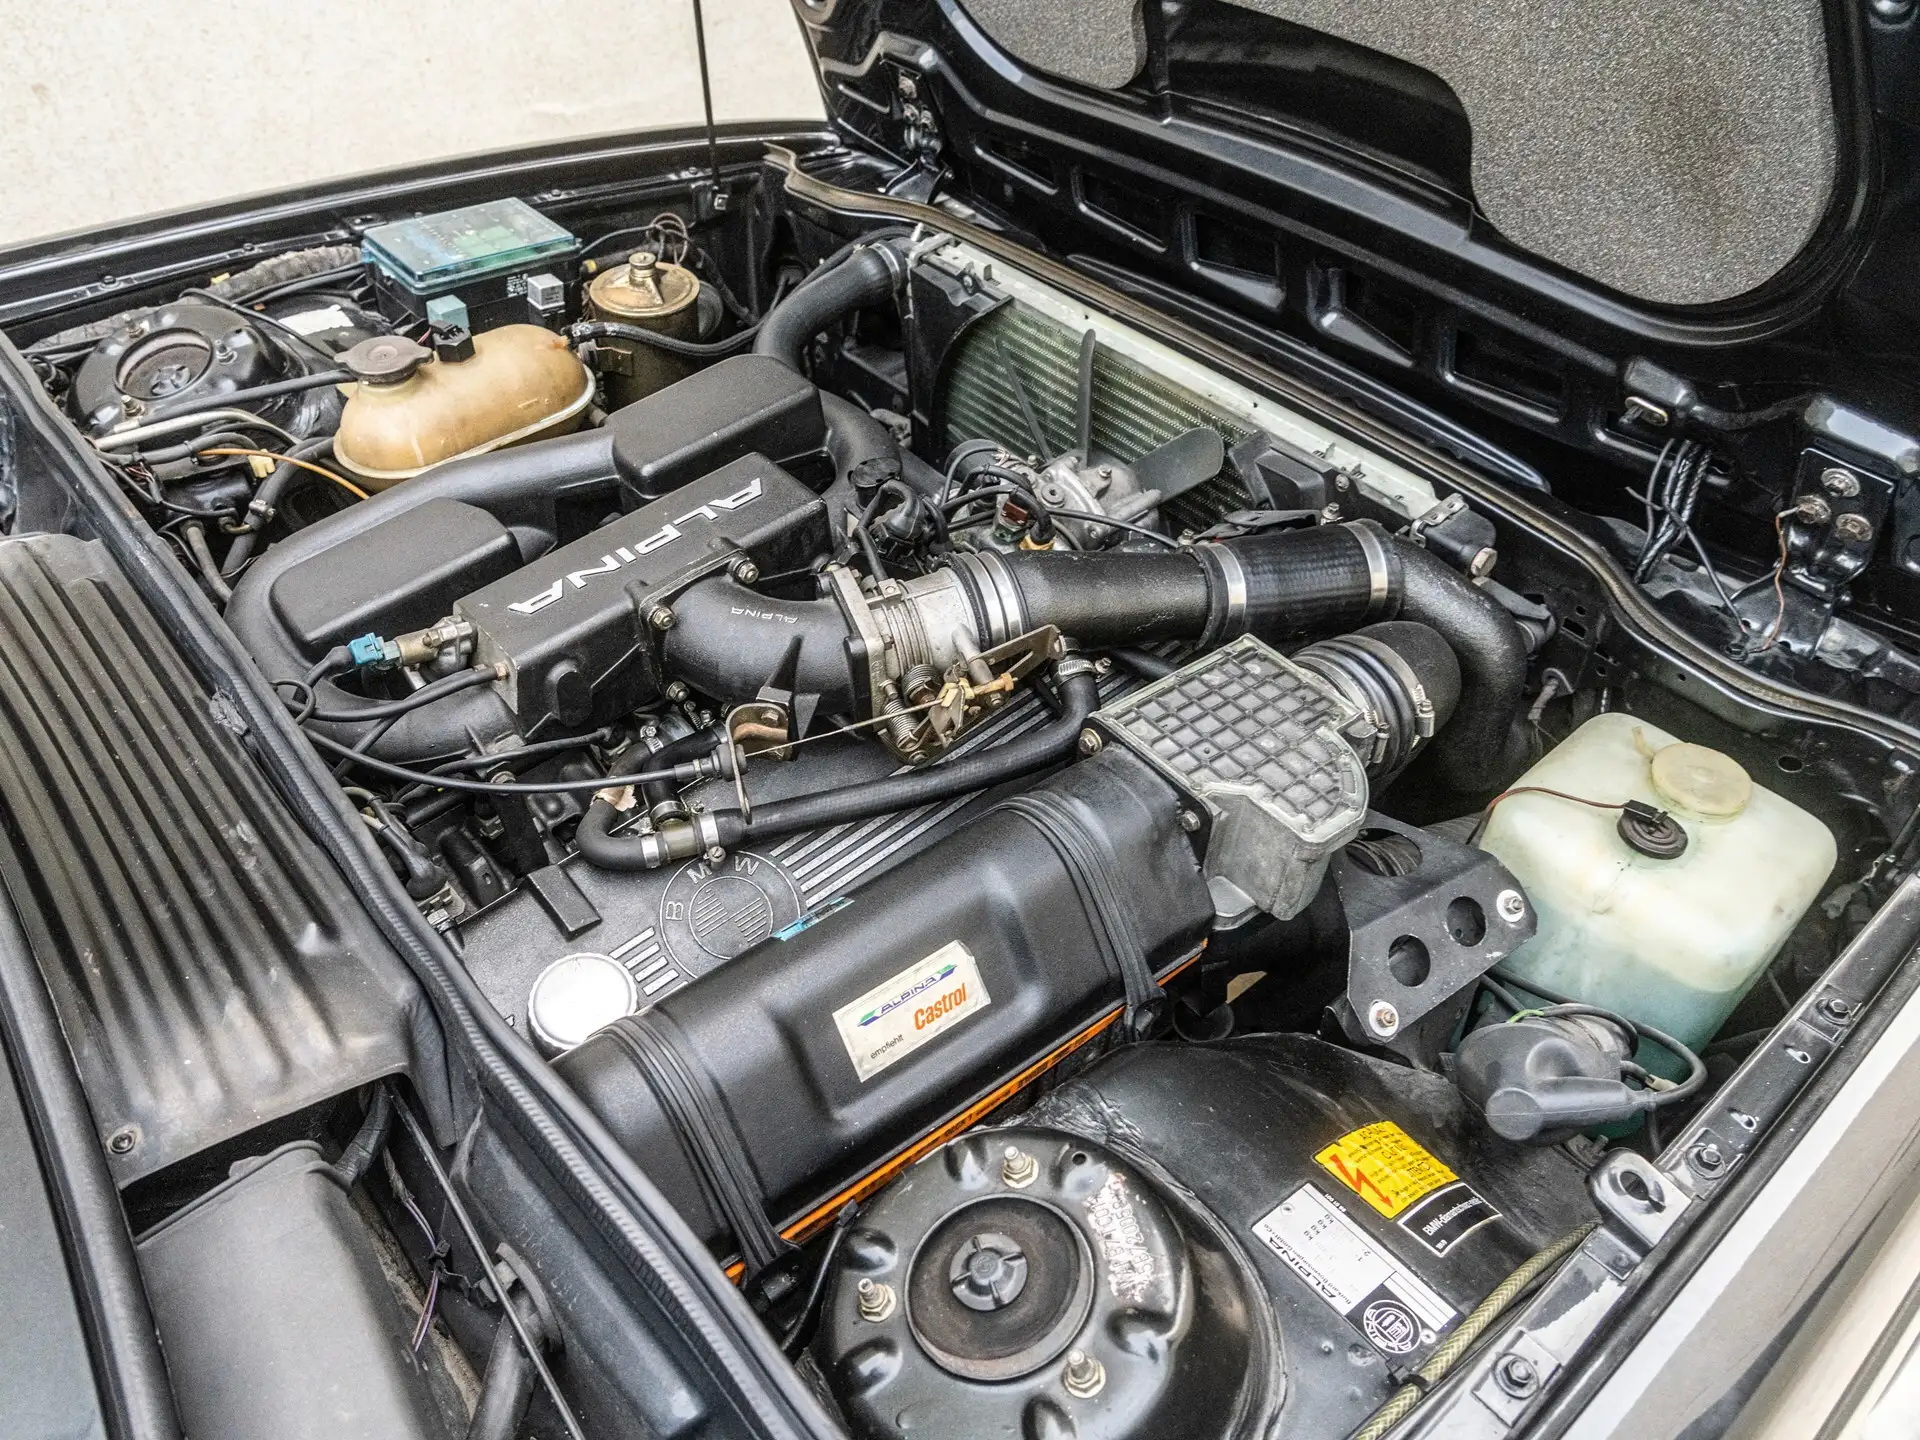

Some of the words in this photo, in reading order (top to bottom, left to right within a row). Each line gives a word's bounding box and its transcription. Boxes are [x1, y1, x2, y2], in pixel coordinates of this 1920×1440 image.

[508, 478, 762, 614] ALPINA
[731, 606, 799, 624] ALPINA
[665, 855, 760, 921] BMW
[881, 976, 937, 1014] ALPINA
[913, 982, 968, 1031] Castrol
[870, 1033, 905, 1060] empfiehlt
[1269, 1236, 1336, 1299] ALPINA
